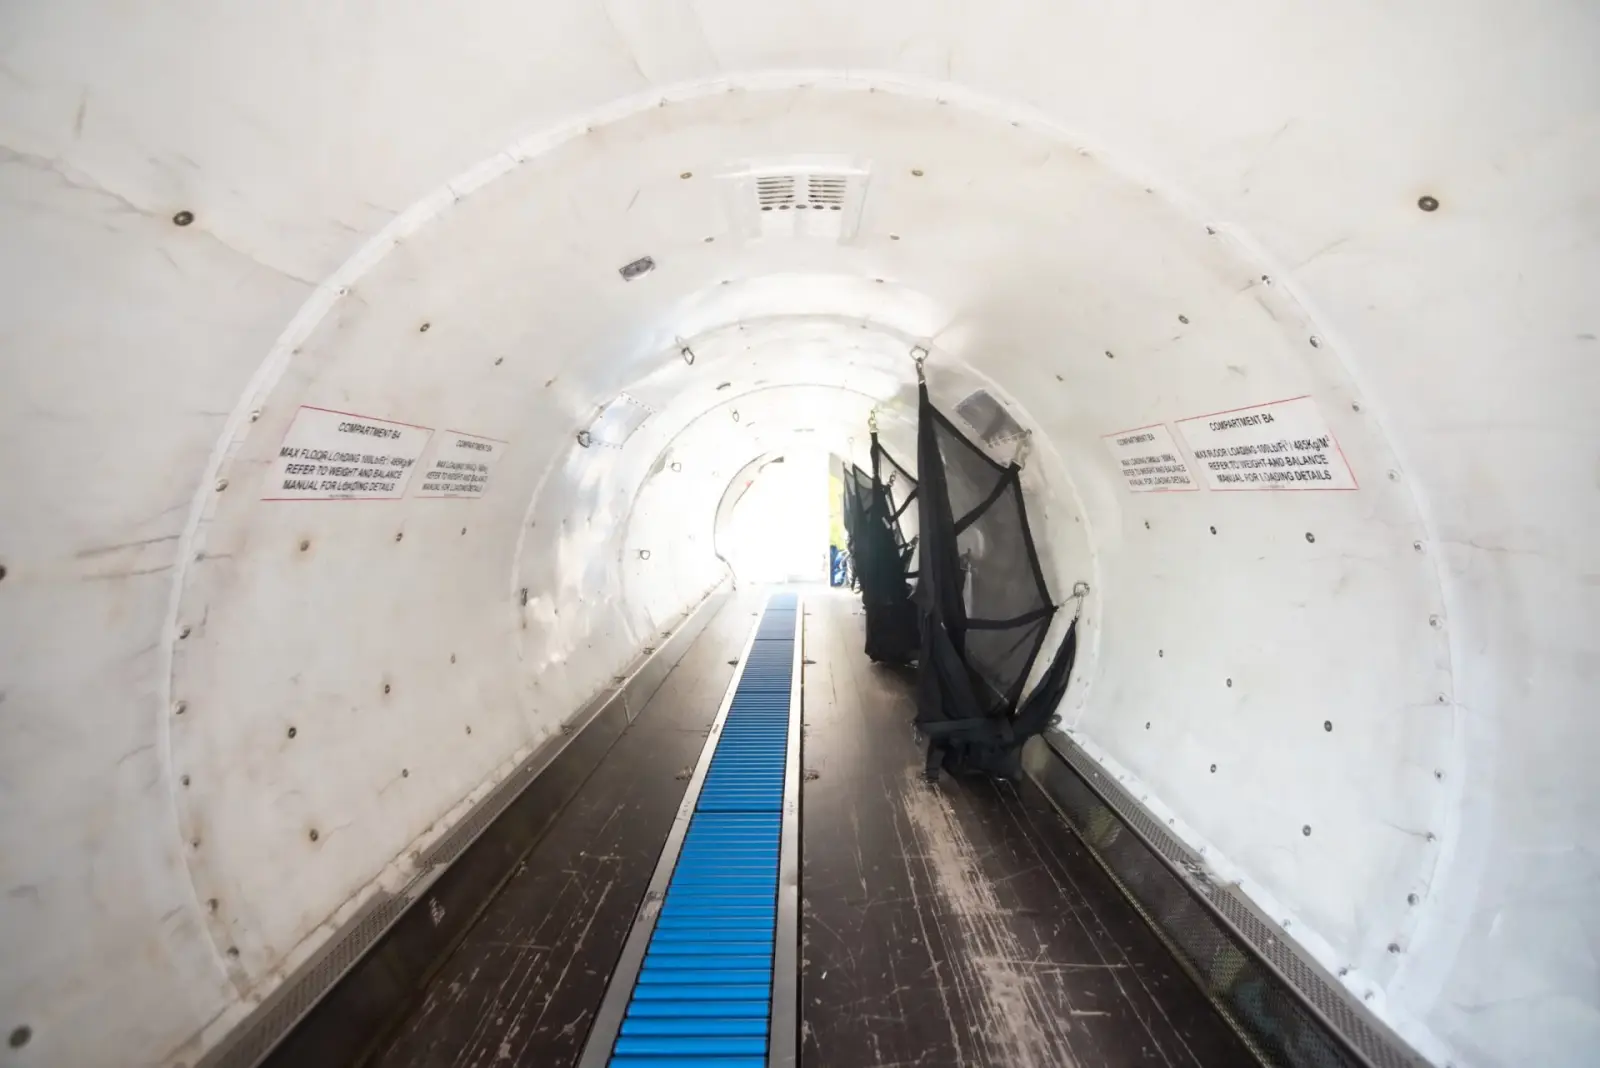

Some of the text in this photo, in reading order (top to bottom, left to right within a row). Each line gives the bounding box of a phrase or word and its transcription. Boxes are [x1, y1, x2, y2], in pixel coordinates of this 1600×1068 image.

[1209, 413, 1274, 432] COMPARTMENT B4
[279, 447, 299, 458] MAX
[1228, 444, 1257, 458] LOADING
[1208, 460, 1229, 470] REFER
[1241, 458, 1266, 470] WEIGHT
[1268, 456, 1285, 467] AND
[1286, 454, 1329, 466] BALANCE
[285, 464, 315, 475] REFER
[317, 465, 327, 476] TO
[328, 466, 359, 478] WEIGHT
[372, 470, 403, 480] BALANCE
[1216, 470, 1332, 484] MANUAL FOR LOADING DETAILS
[282, 480, 318, 490] MANUAL
[320, 480, 336, 490] FOR
[368, 482, 396, 492] DETAILS
